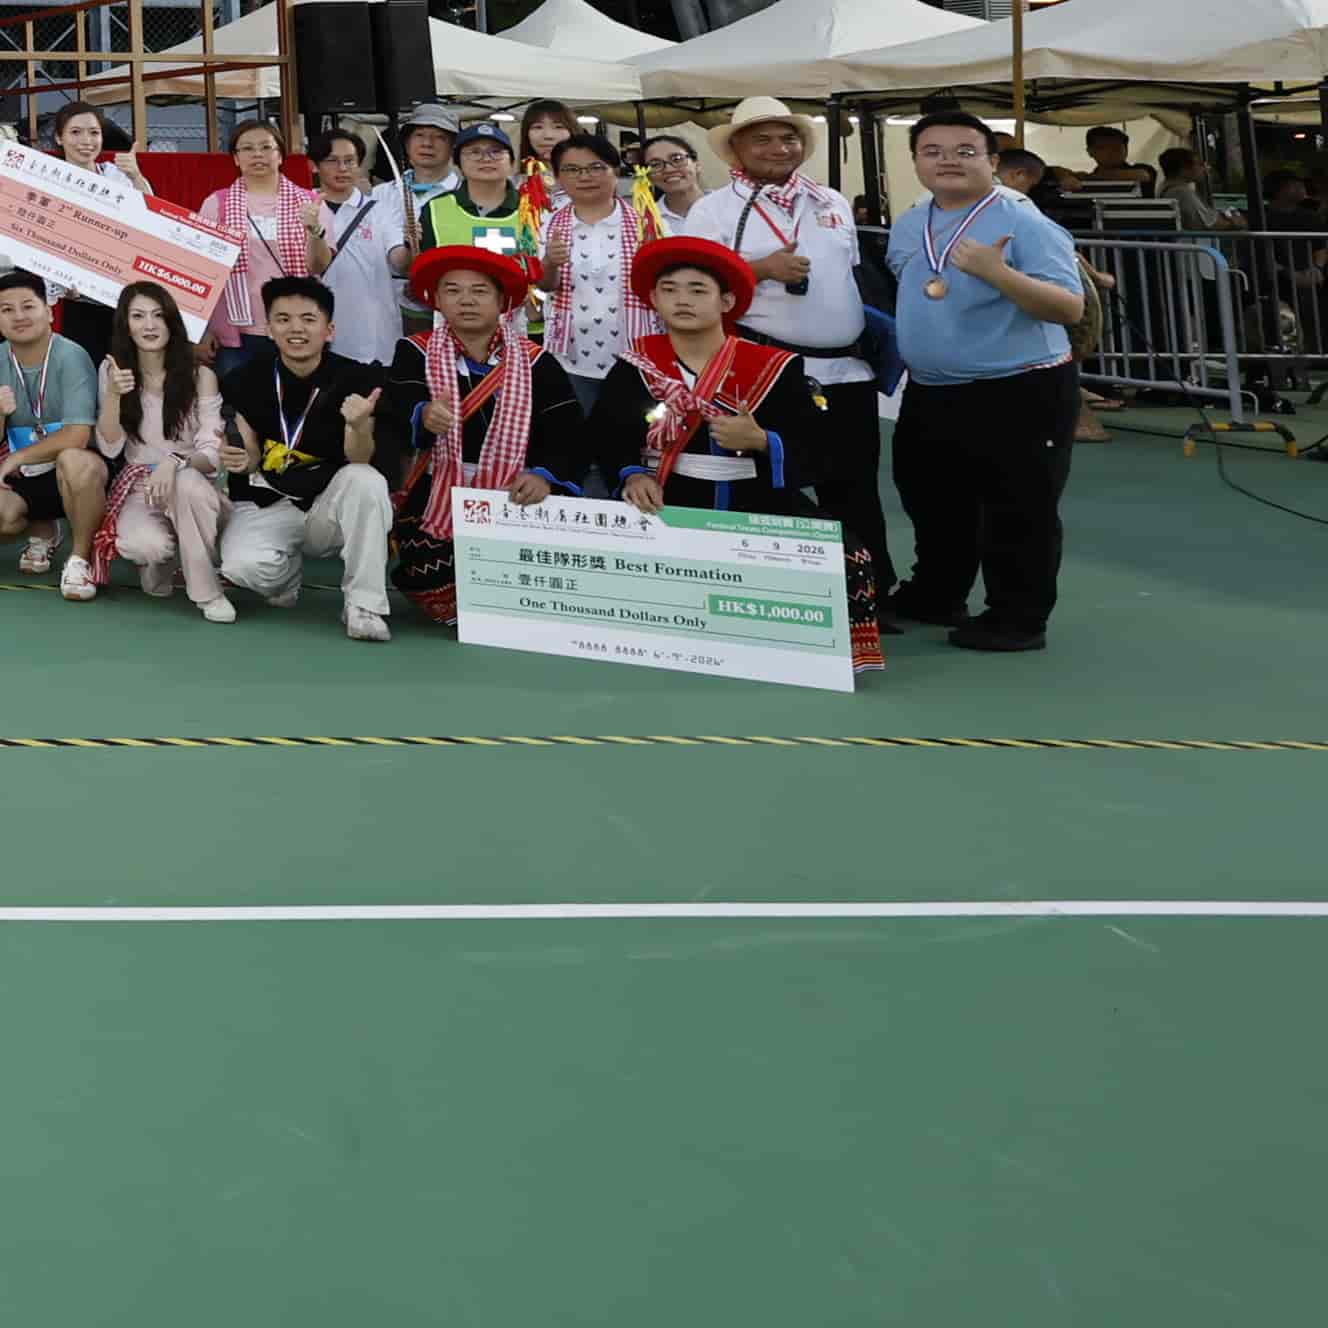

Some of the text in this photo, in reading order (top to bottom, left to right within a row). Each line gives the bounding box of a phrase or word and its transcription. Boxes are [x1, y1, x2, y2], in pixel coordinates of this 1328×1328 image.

[797, 543, 825, 555] 2026
[519, 547, 744, 583] 最佳隊形獎 Best Formation
[519, 597, 708, 630] One Thousand Dollars Only
[718, 599, 825, 624] HK$1,000.00
